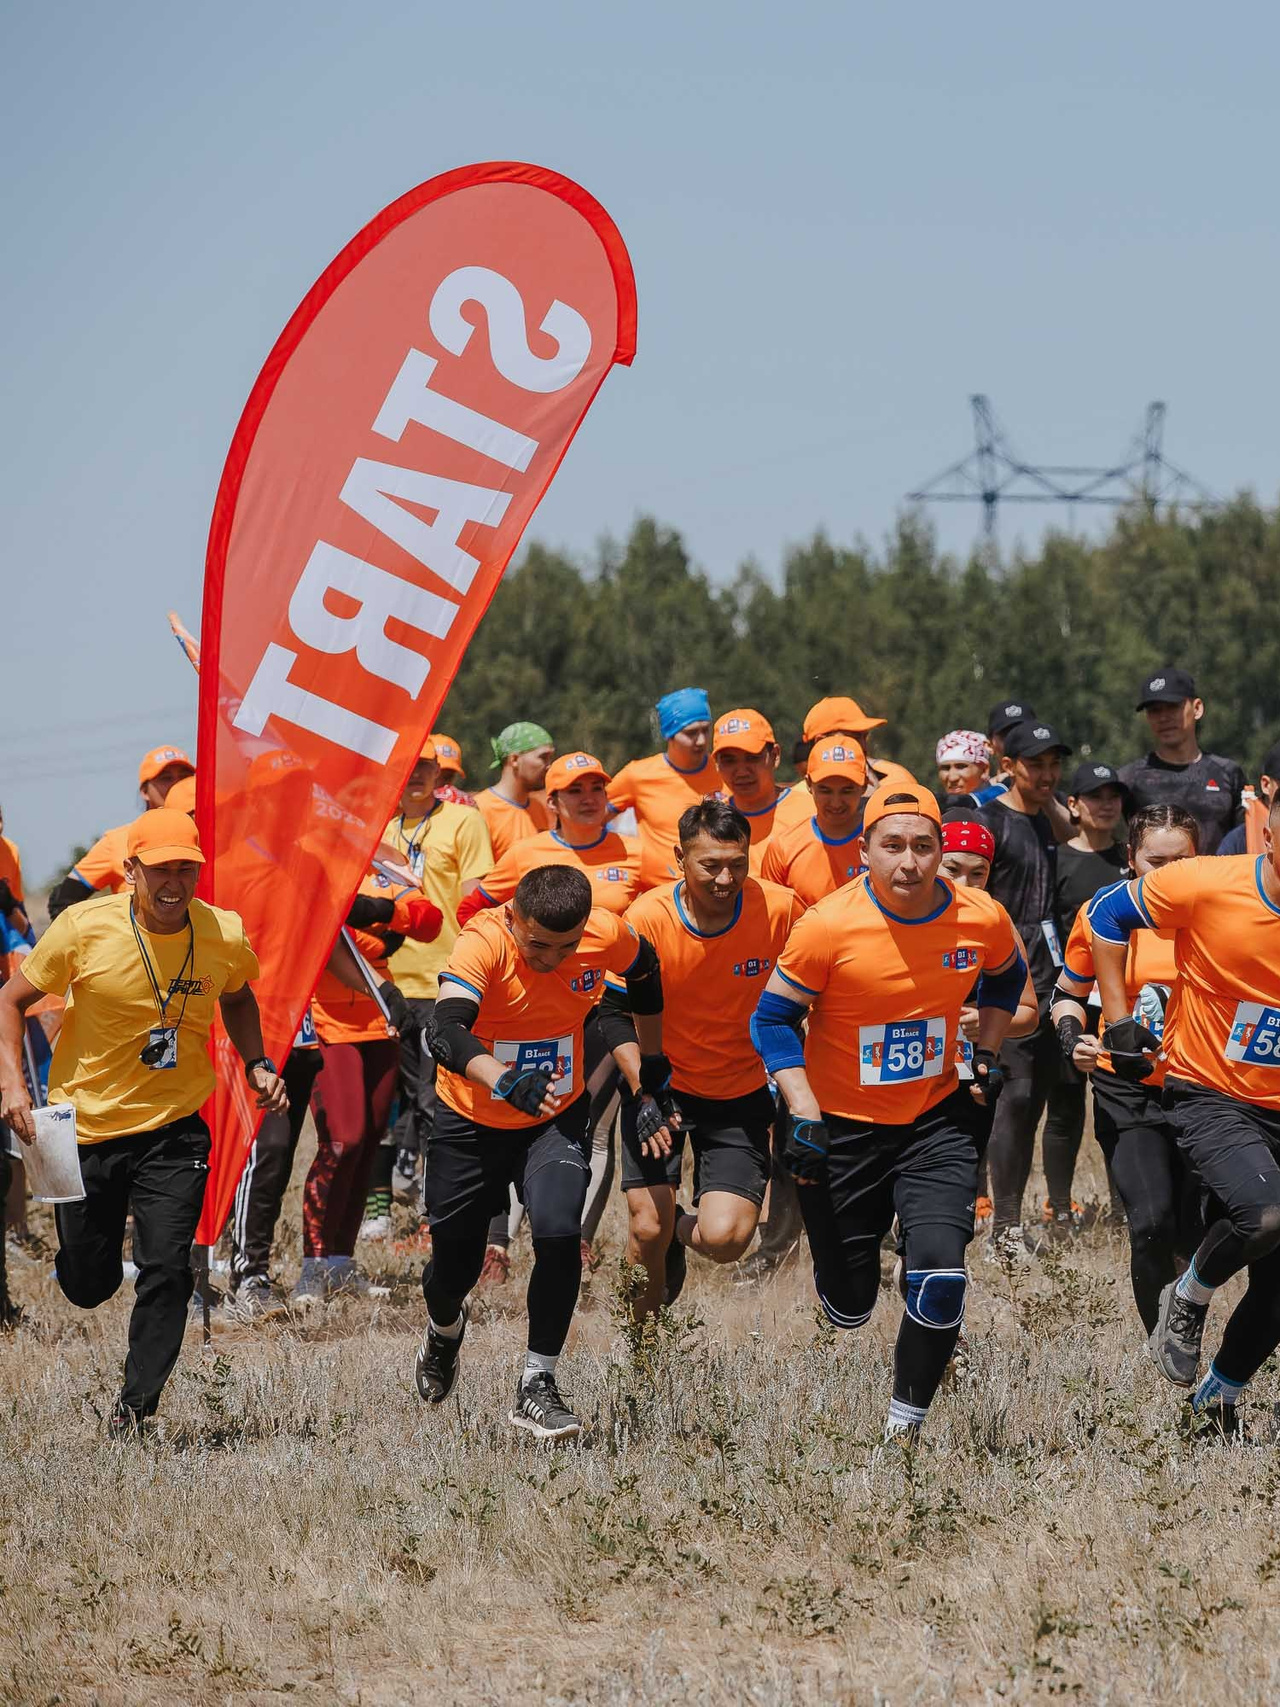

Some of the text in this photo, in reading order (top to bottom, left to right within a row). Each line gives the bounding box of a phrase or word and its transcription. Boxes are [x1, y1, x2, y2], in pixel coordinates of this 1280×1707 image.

[892, 1028, 906, 1038] BI
[525, 1049, 539, 1059] BI
[887, 1041, 924, 1072] 58
